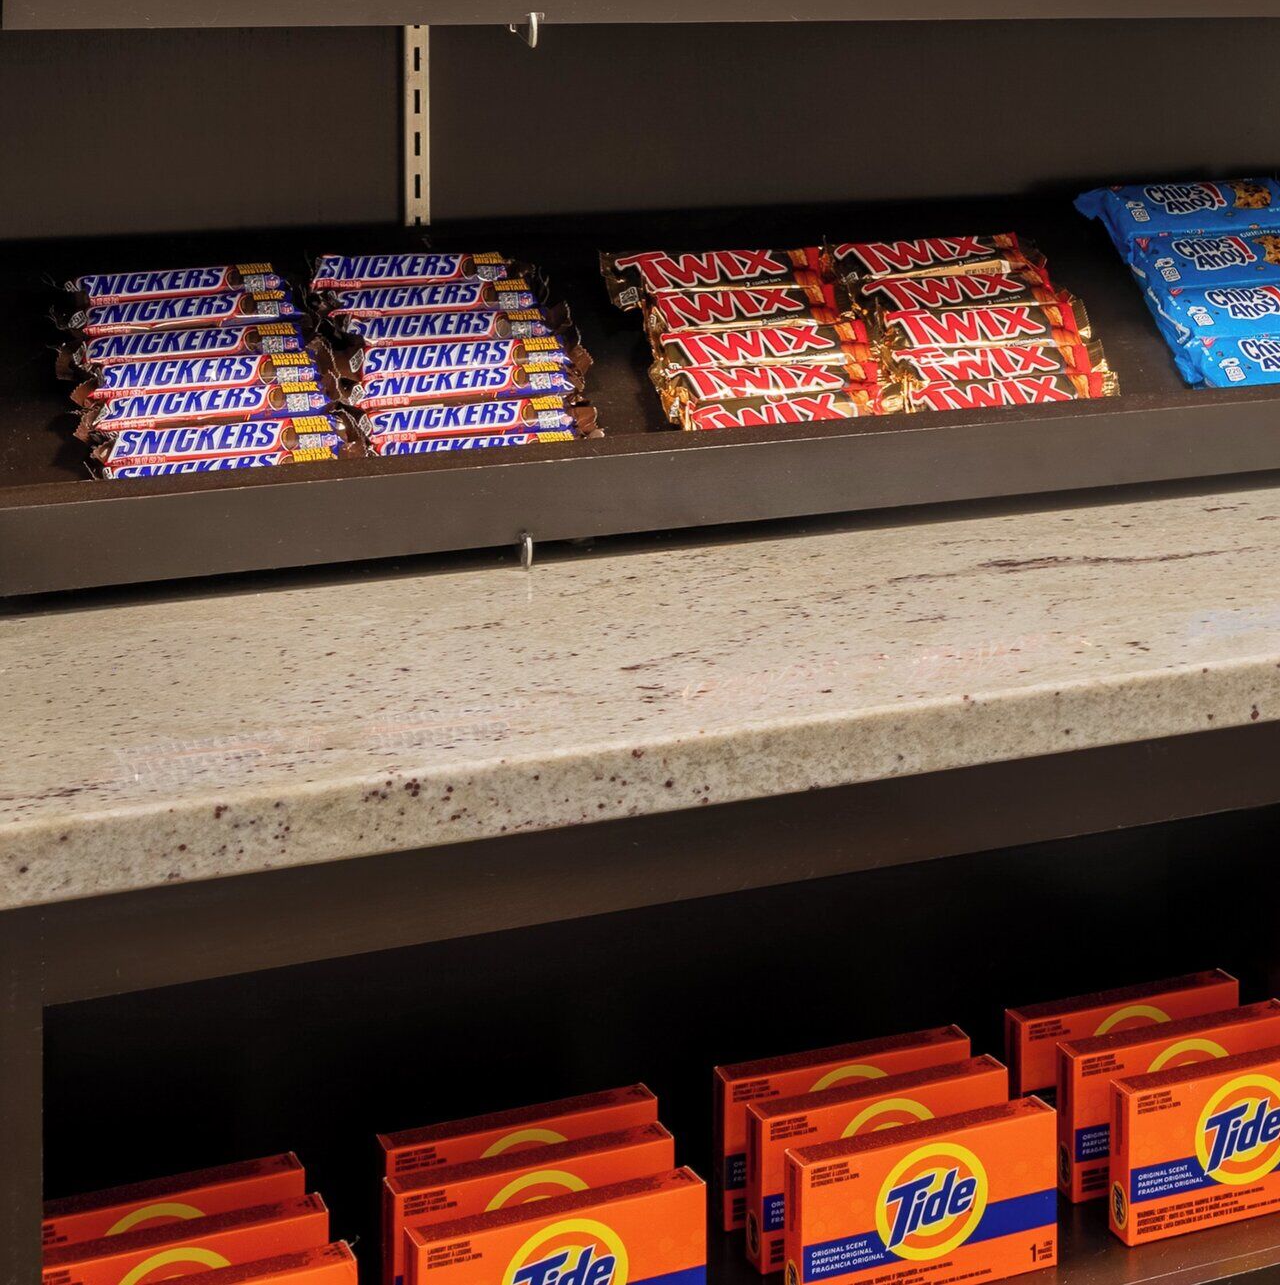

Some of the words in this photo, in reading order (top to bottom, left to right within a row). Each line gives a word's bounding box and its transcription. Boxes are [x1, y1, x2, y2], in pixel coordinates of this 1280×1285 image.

[1147, 183, 1204, 205] Chips
[1165, 188, 1224, 214] Ahoy!
[833, 234, 996, 276] TWIX
[1174, 236, 1235, 259] Chips
[1196, 242, 1256, 270] Ahoy!
[318, 254, 459, 280] SNICKERS
[614, 249, 788, 292] TWIX
[78, 267, 224, 297] SNICKERS
[495, 284, 530, 292] MISTAKE
[861, 272, 1027, 311] TWIX
[87, 293, 238, 326] SNICKERS
[339, 283, 481, 310] SNICKERS
[656, 288, 805, 331] TWIX
[1206, 286, 1269, 308] Chips
[350, 312, 494, 339] SNICKERS
[885, 306, 1046, 347] TWIX
[1195, 313, 1212, 322] 220
[88, 328, 243, 359] SNICKERS
[522, 336, 557, 345] ROOKIE
[524, 343, 560, 351] MISTAKE
[659, 324, 836, 366] TWIX
[272, 358, 311, 366] MISTAKE
[365, 340, 511, 375] SNICKERS
[102, 356, 260, 389] SNICKERS
[363, 368, 509, 399] SNICKERS
[1226, 367, 1244, 377] 220
[105, 386, 265, 421] SNICKERS
[372, 401, 519, 436] SNICKERS
[114, 422, 280, 458] SNICKERS
[293, 453, 335, 462] MISTAKE
[1082, 1138, 1107, 1148] PARFUM
[1137, 1177, 1163, 1188] PARFUM
[1163, 1171, 1193, 1183] ORIGINAL
[1137, 1184, 1174, 1196] FRAGANCIA
[1174, 1176, 1203, 1189] ORIGINAL
[1138, 1168, 1168, 1181] ORIGINAL
[1169, 1164, 1188, 1175] SCENT
[886, 1166, 978, 1251] Tide
[811, 1244, 844, 1259] ORIGINAL
[845, 1239, 868, 1251] SCENT
[811, 1253, 839, 1266] PARFUM
[840, 1247, 873, 1260] ORIGINAL
[511, 1244, 617, 1285] Tide
[811, 1260, 852, 1275] FRAGANCIA
[852, 1252, 885, 1266] ORIGINAL
